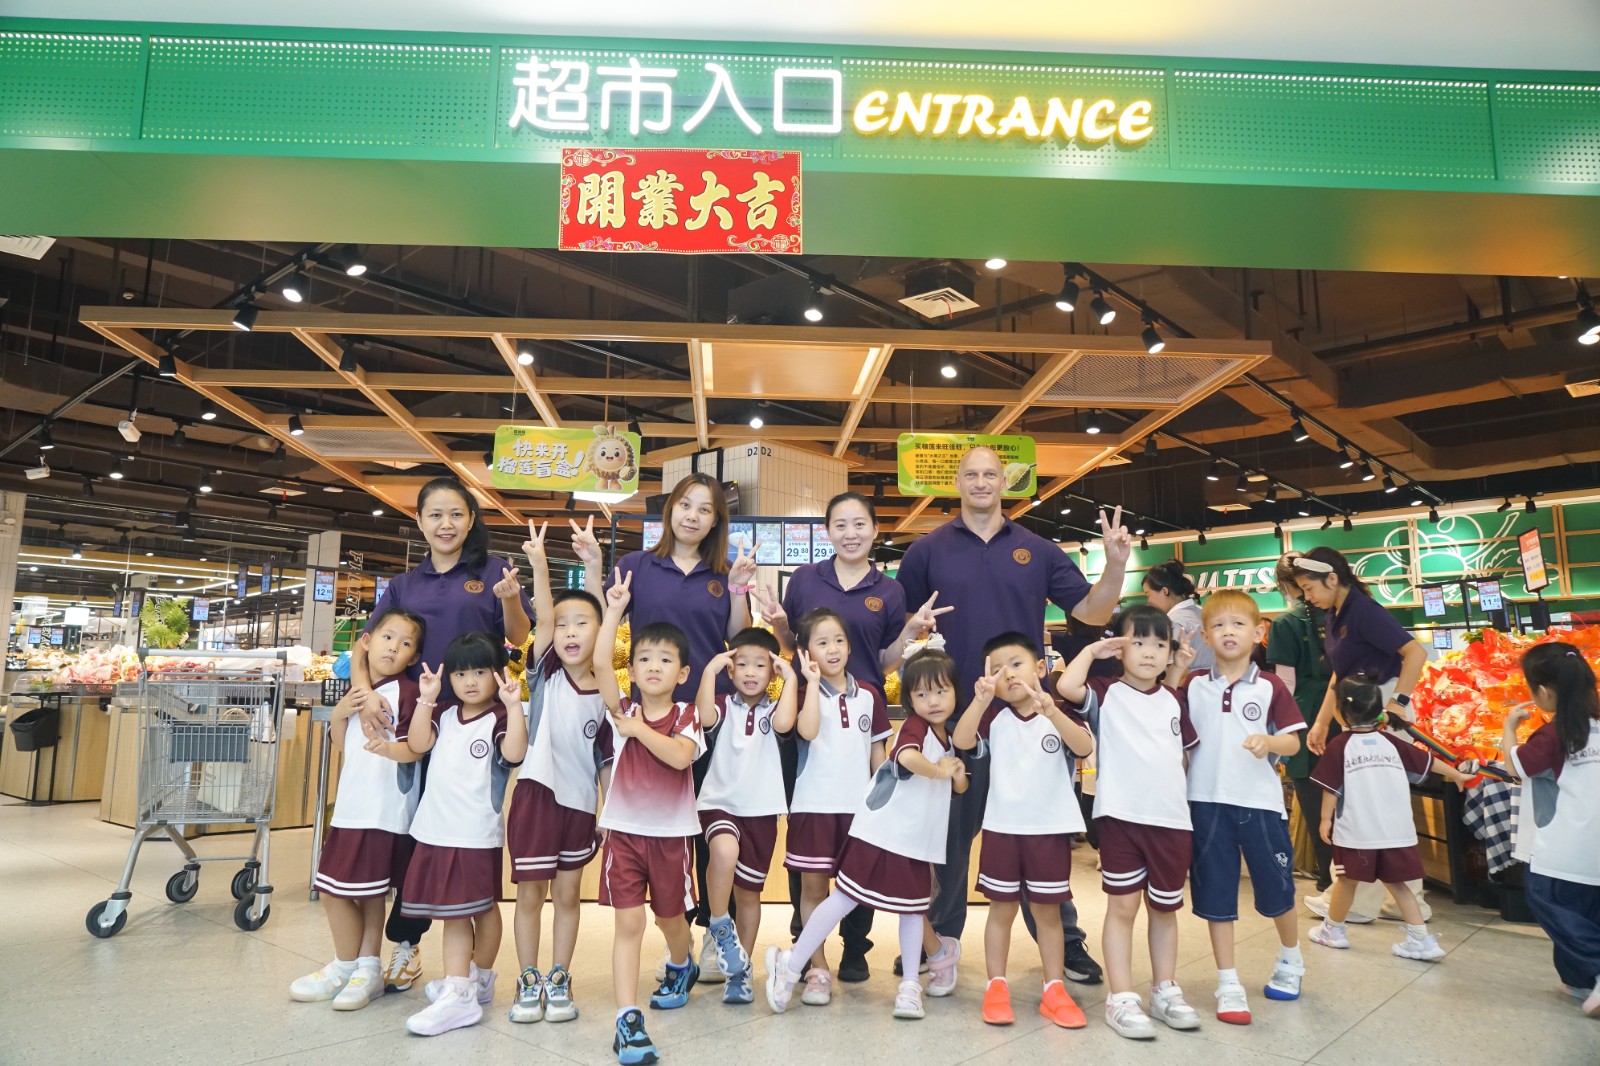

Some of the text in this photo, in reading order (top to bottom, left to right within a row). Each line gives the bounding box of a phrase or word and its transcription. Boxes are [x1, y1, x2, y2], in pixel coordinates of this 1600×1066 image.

[507, 55, 843, 136] 超市入口
[853, 89, 1154, 144] ENTRANCE
[574, 169, 786, 231] 開業大吉
[512, 438, 568, 460] 快来开
[747, 446, 758, 457] D2
[760, 446, 772, 457] D2
[1183, 566, 1275, 598] UITS
